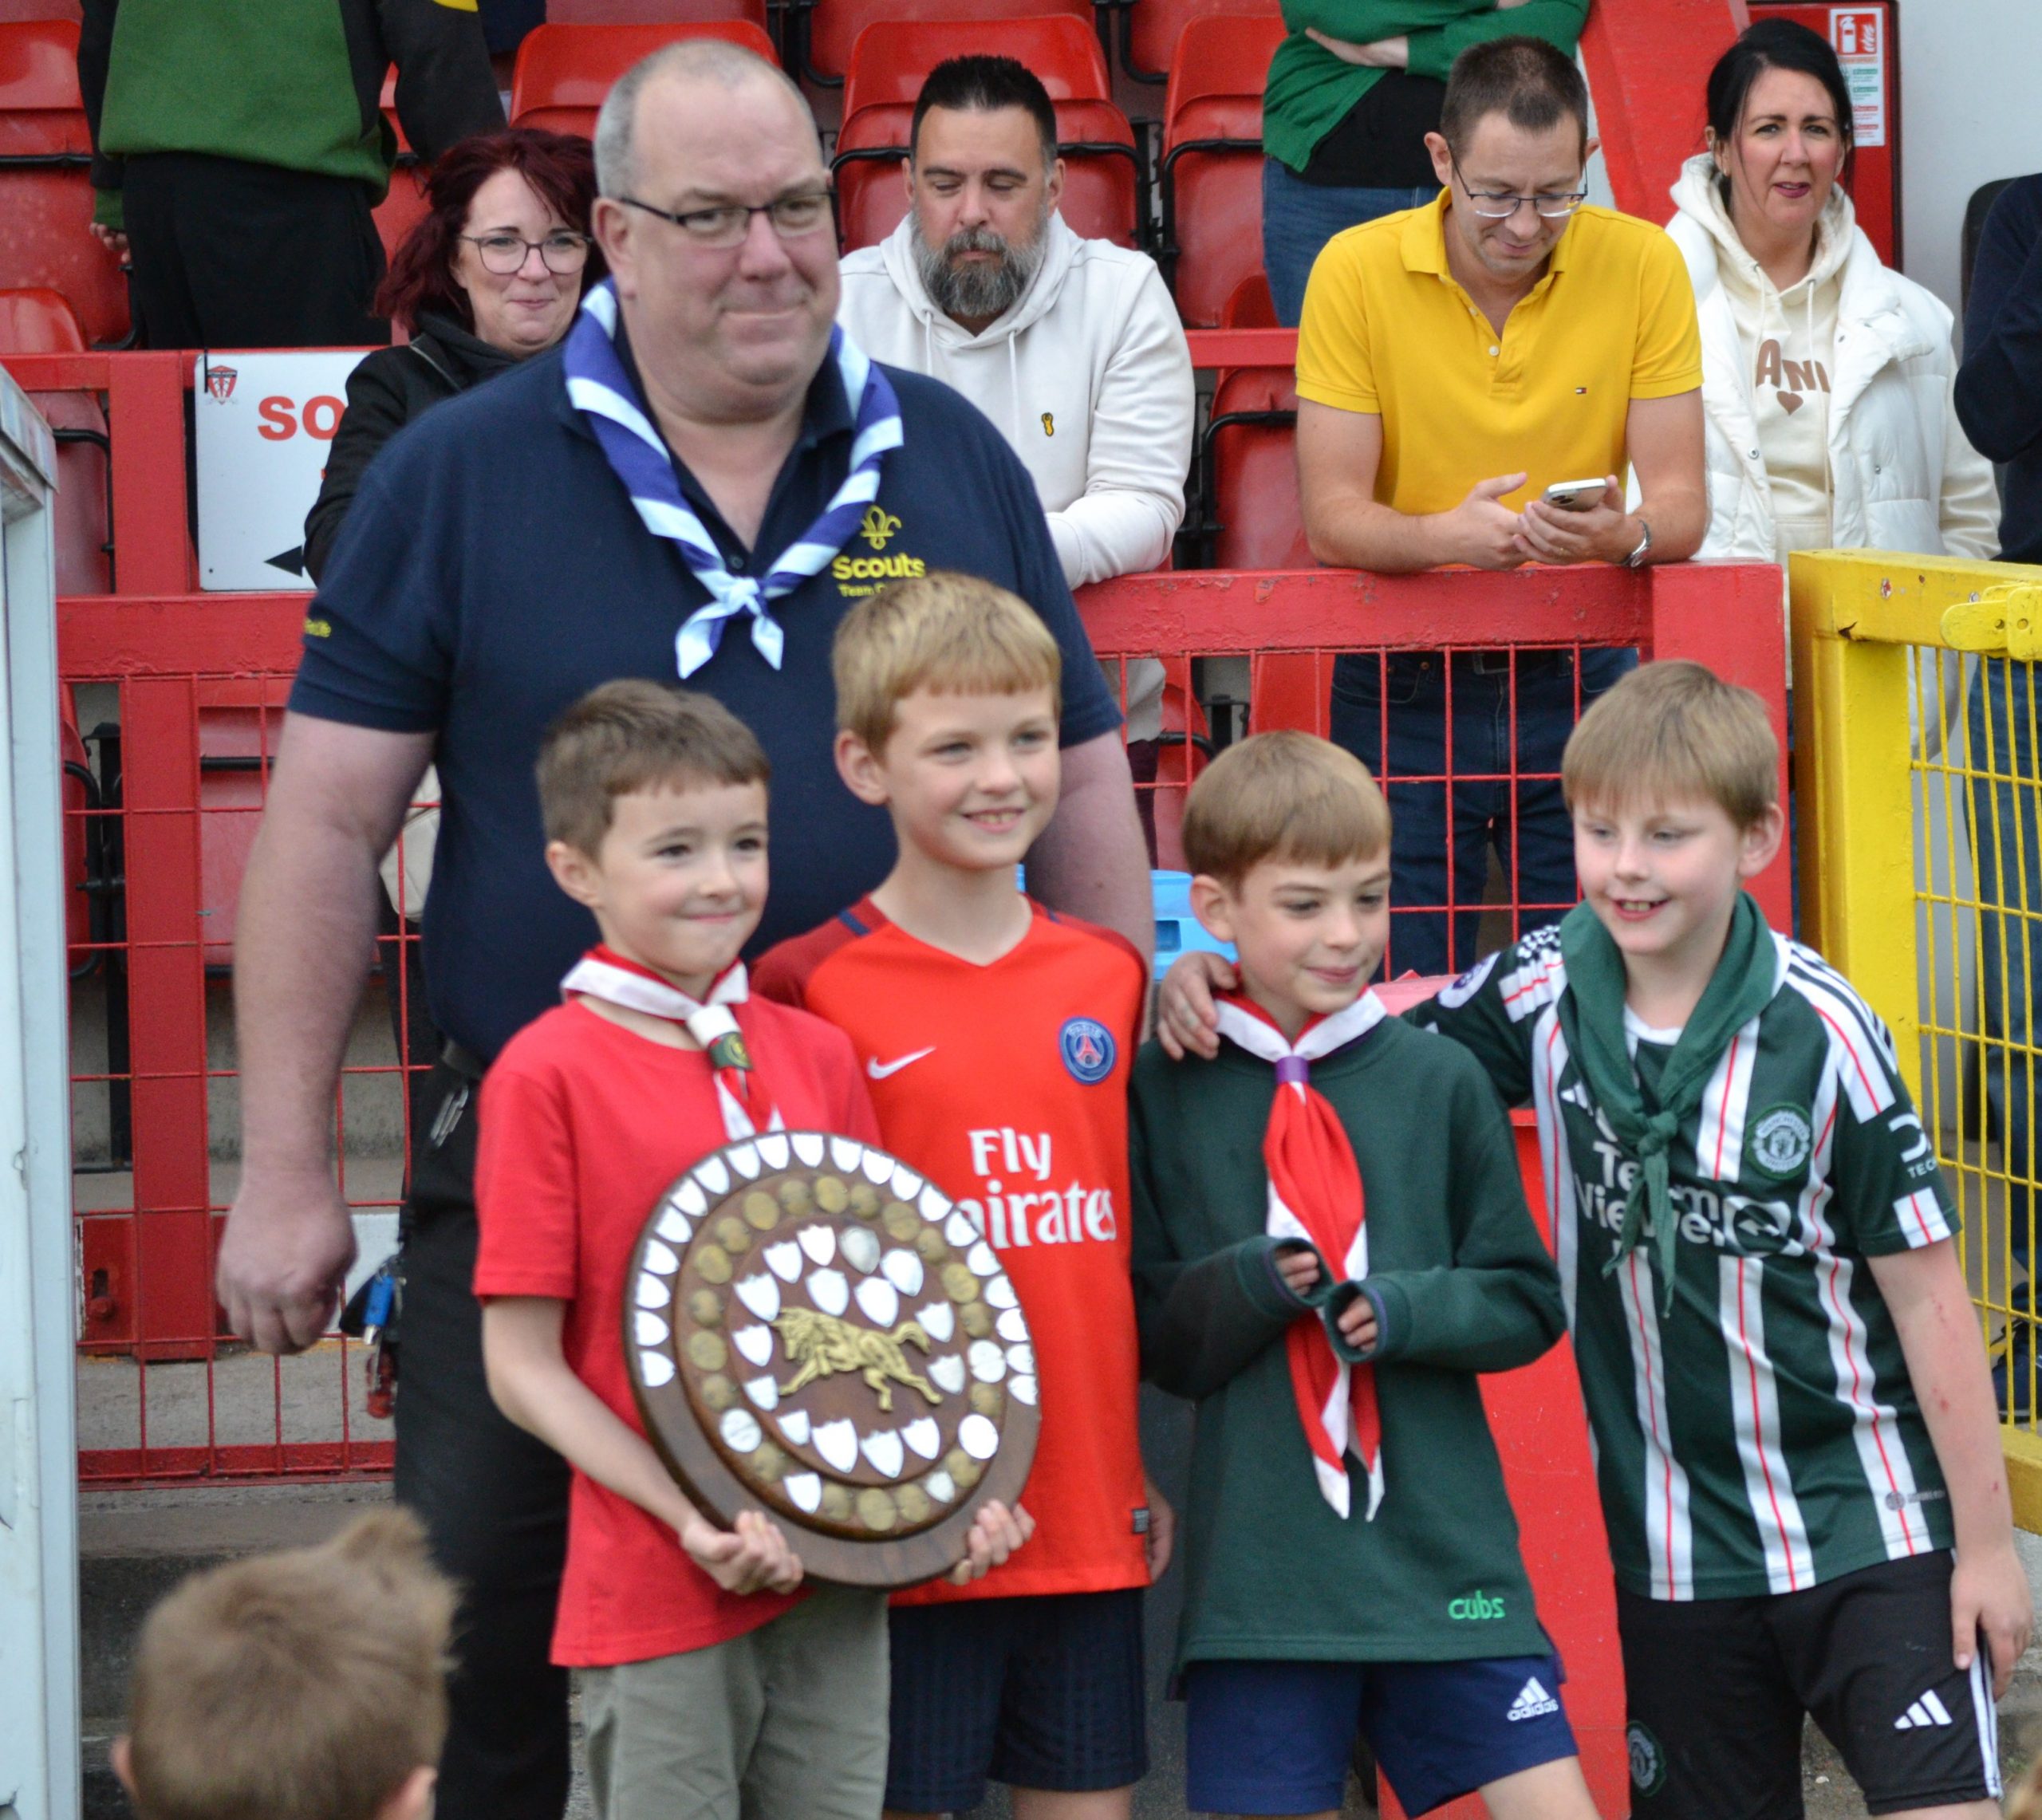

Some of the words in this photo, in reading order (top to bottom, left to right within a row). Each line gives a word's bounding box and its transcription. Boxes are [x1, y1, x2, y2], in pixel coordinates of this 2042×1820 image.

[832, 552, 925, 580] Scouts
[968, 1127, 1051, 1181] Fly
[1593, 1140, 1719, 1221] Tem
[1448, 1590, 1506, 1620] cubs
[1506, 1699, 1559, 1721] adidas
